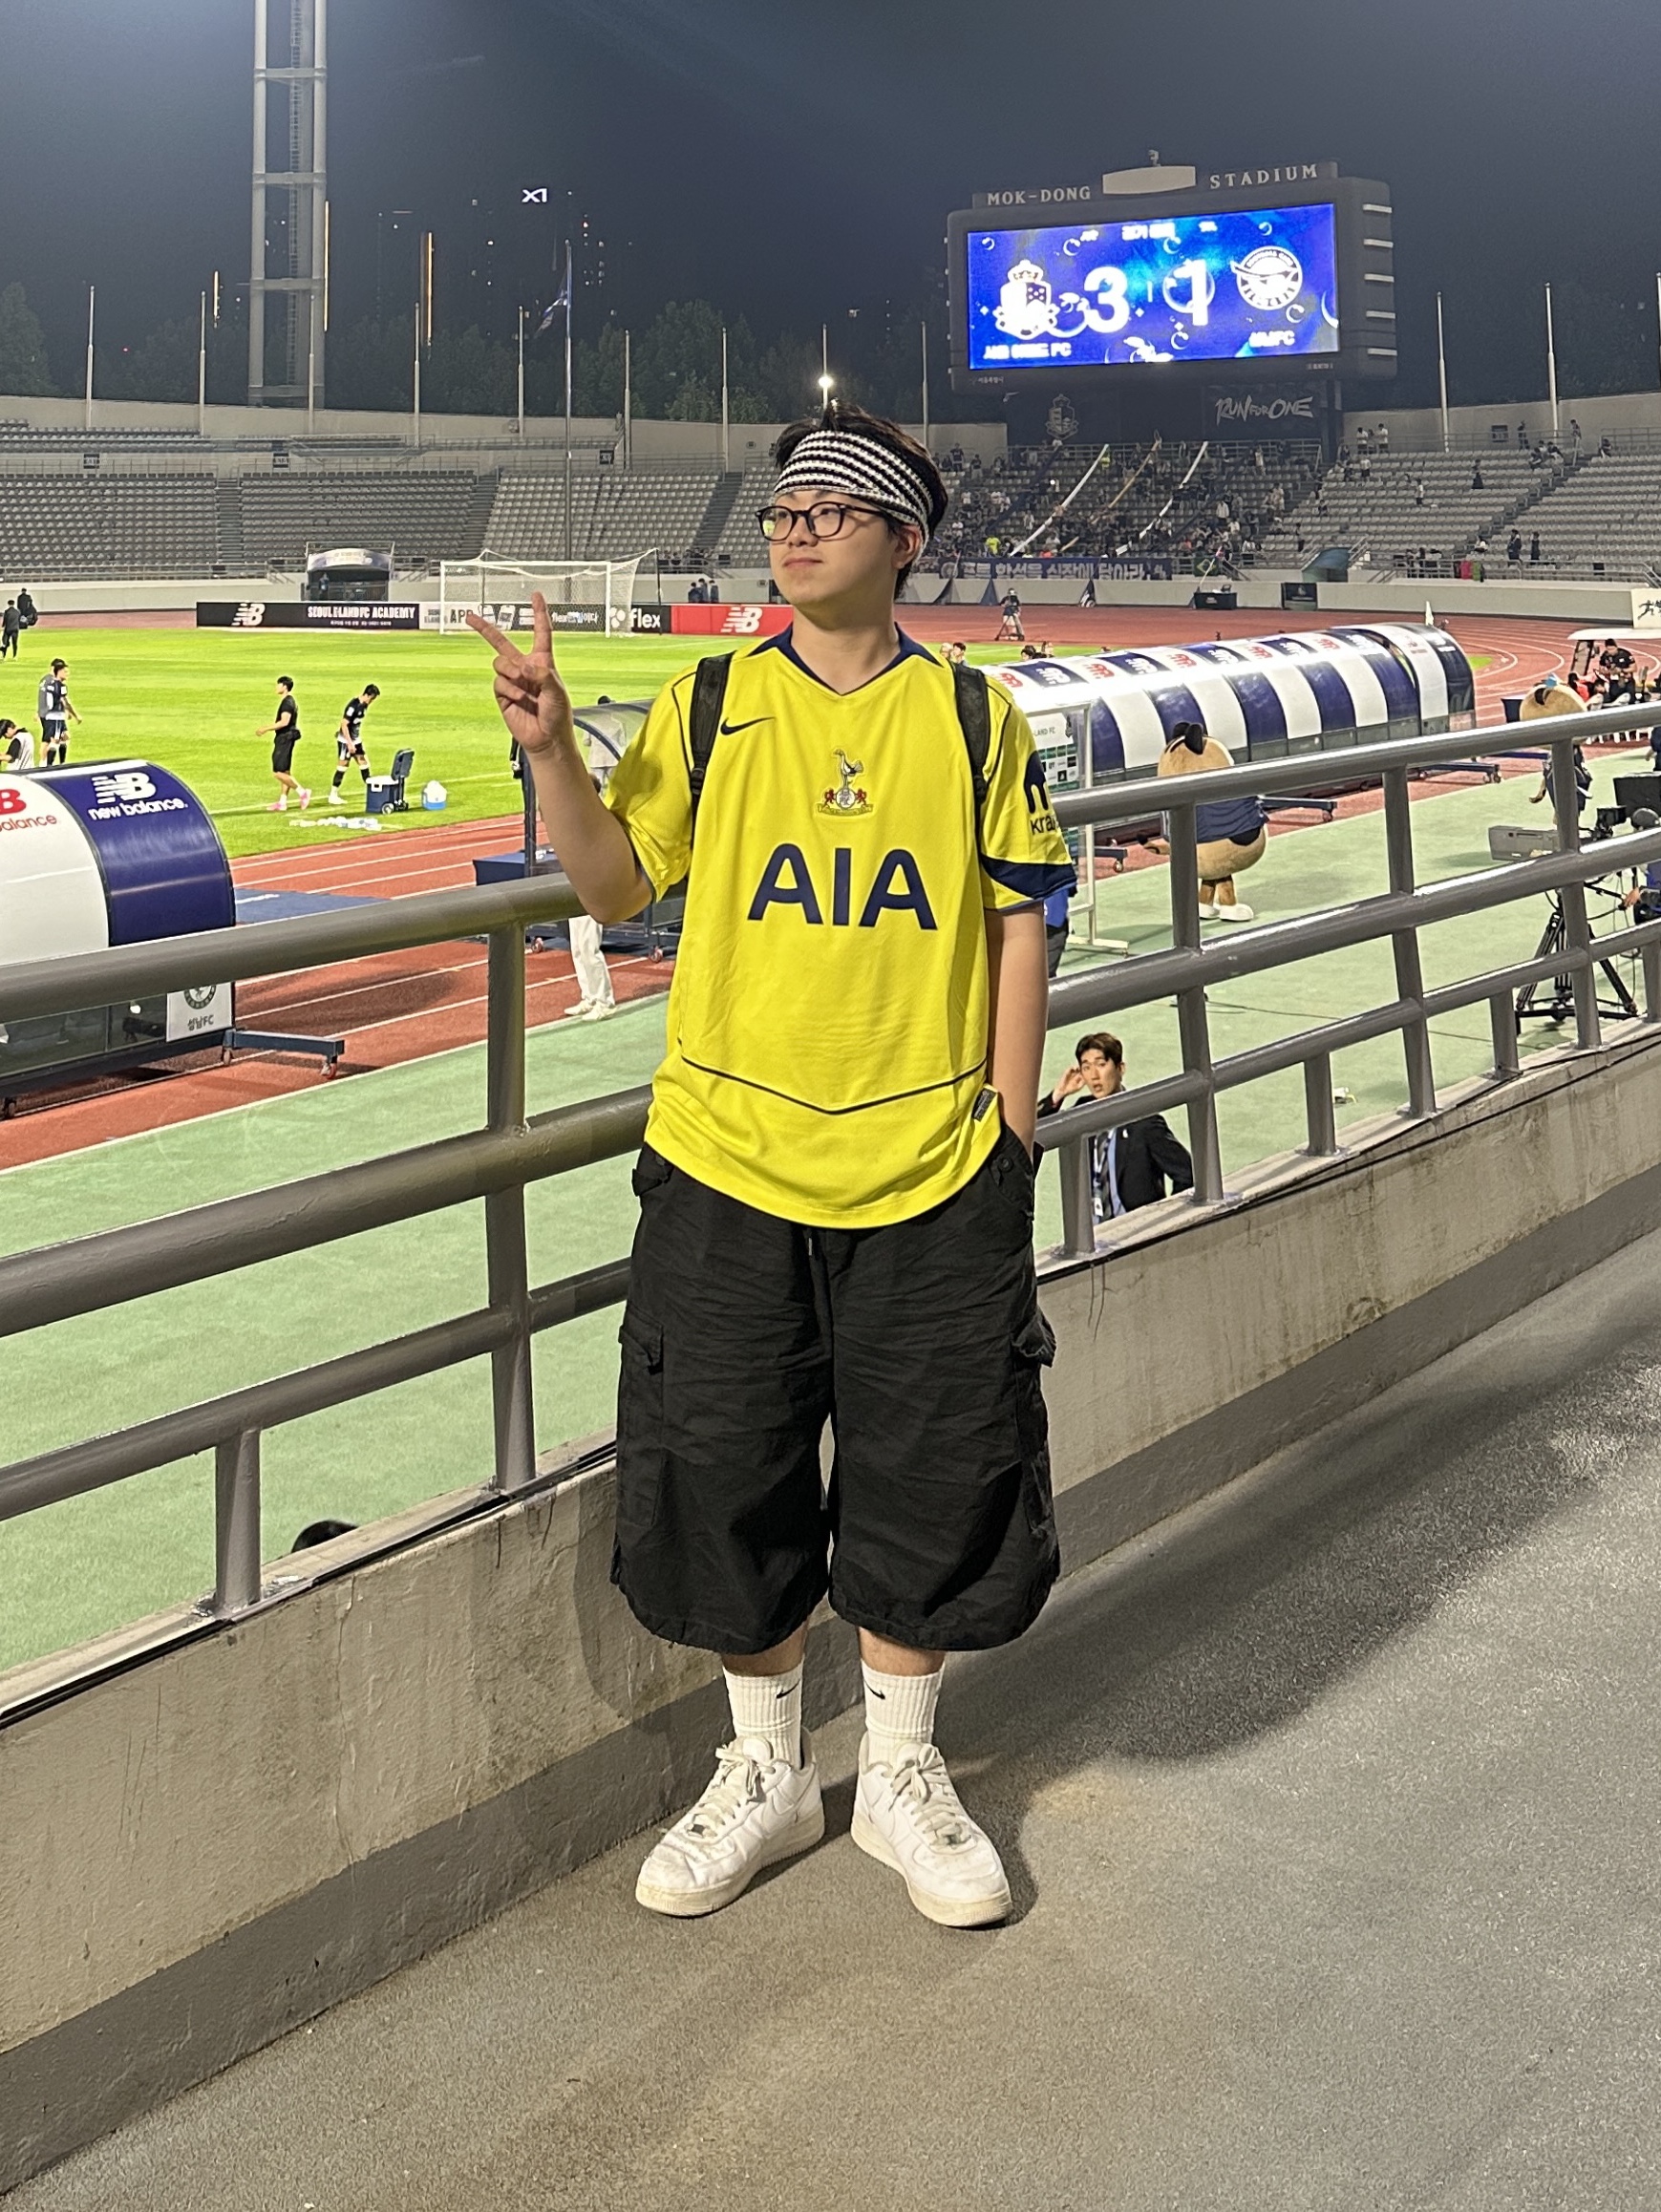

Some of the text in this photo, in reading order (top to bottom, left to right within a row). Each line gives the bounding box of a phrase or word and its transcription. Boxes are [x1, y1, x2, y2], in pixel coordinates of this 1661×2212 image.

[987, 163, 1318, 206] MOK-DONG STADIUM
[1083, 266, 1130, 333] 3
[1173, 258, 1209, 326] 1
[1214, 393, 1252, 427] RUN
[1267, 395, 1313, 419] ONE
[307, 606, 332, 618] SEOUL
[372, 606, 415, 619] ACADEMY
[630, 607, 661, 628] flex
[0, 788, 27, 816] B
[88, 804, 122, 820] new
[1030, 813, 1057, 836] kra
[747, 842, 938, 930] AIA
